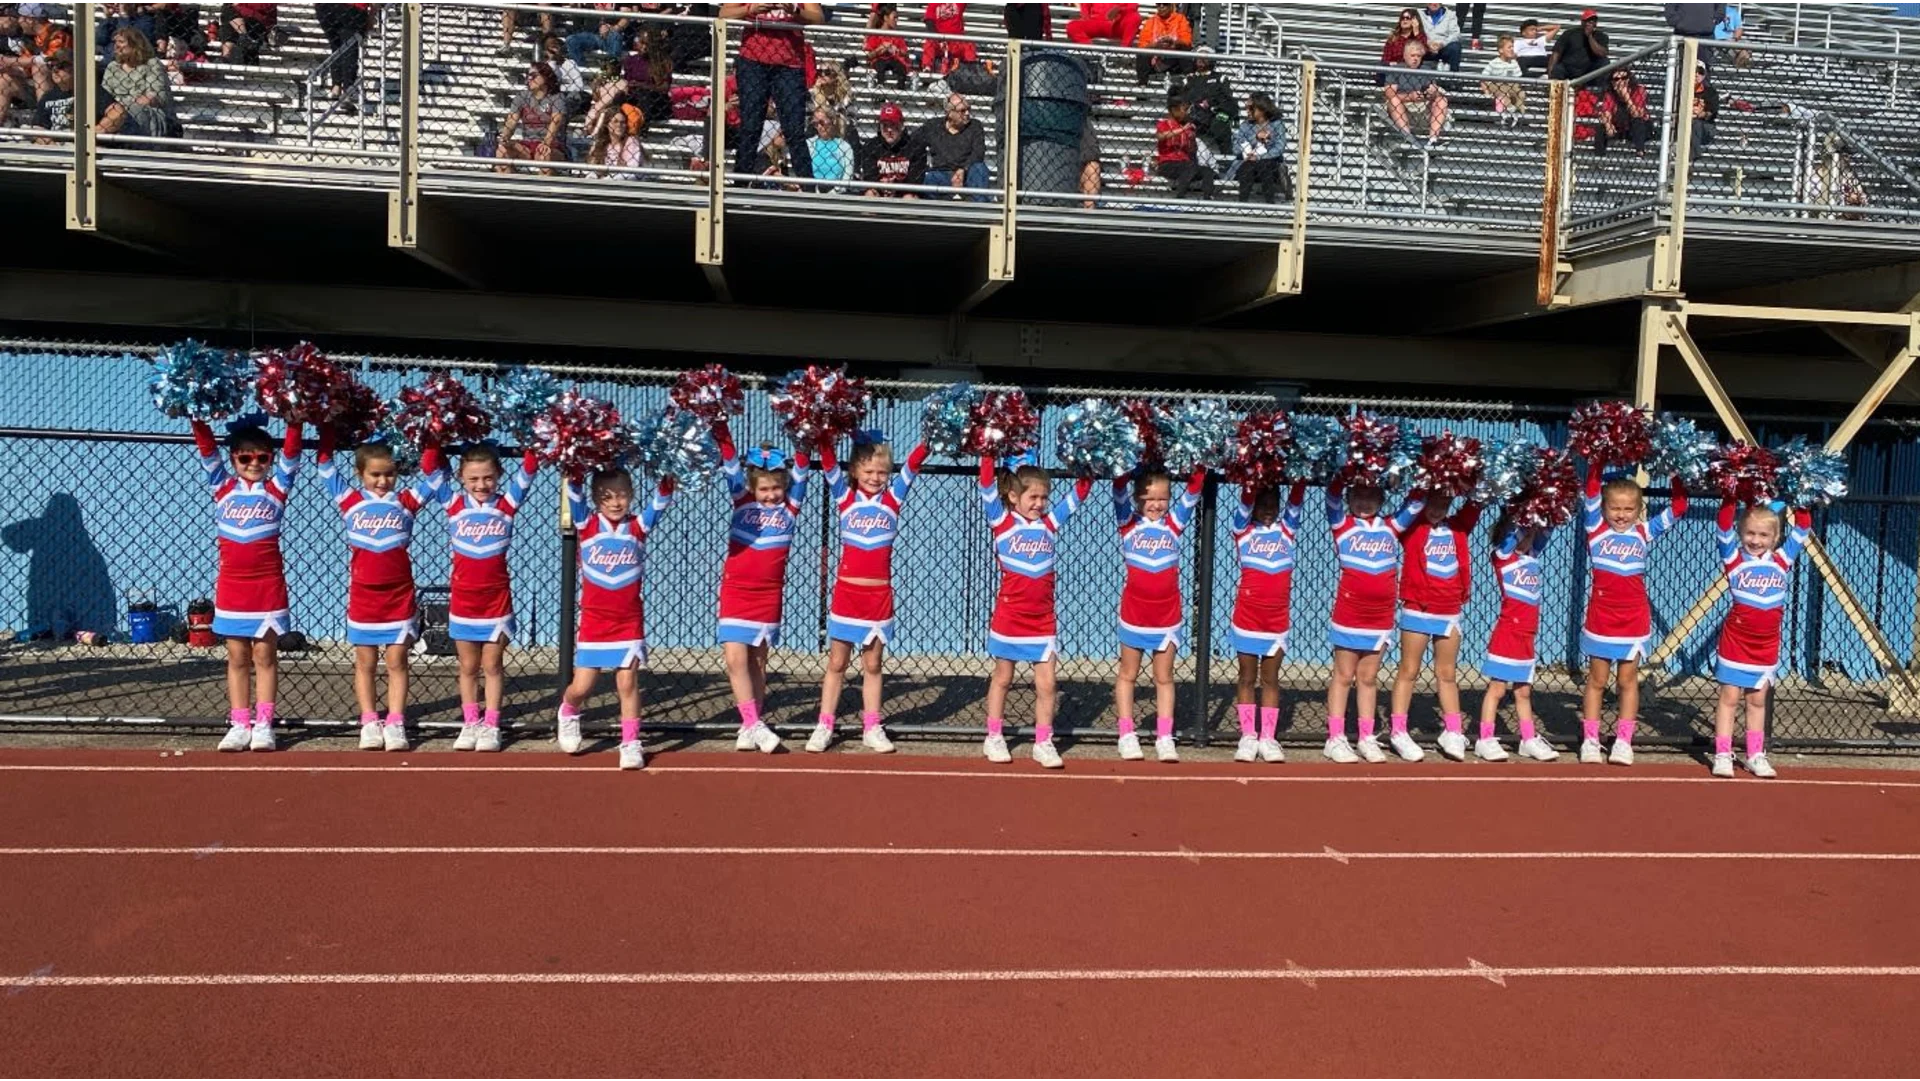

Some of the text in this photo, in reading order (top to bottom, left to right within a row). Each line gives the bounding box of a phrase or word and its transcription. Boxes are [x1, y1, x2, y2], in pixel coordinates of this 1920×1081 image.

[221, 499, 275, 528] Knights
[352, 512, 403, 536] Knights
[846, 511, 891, 534] Knights
[455, 519, 506, 543] Knights
[587, 545, 638, 573] Knights
